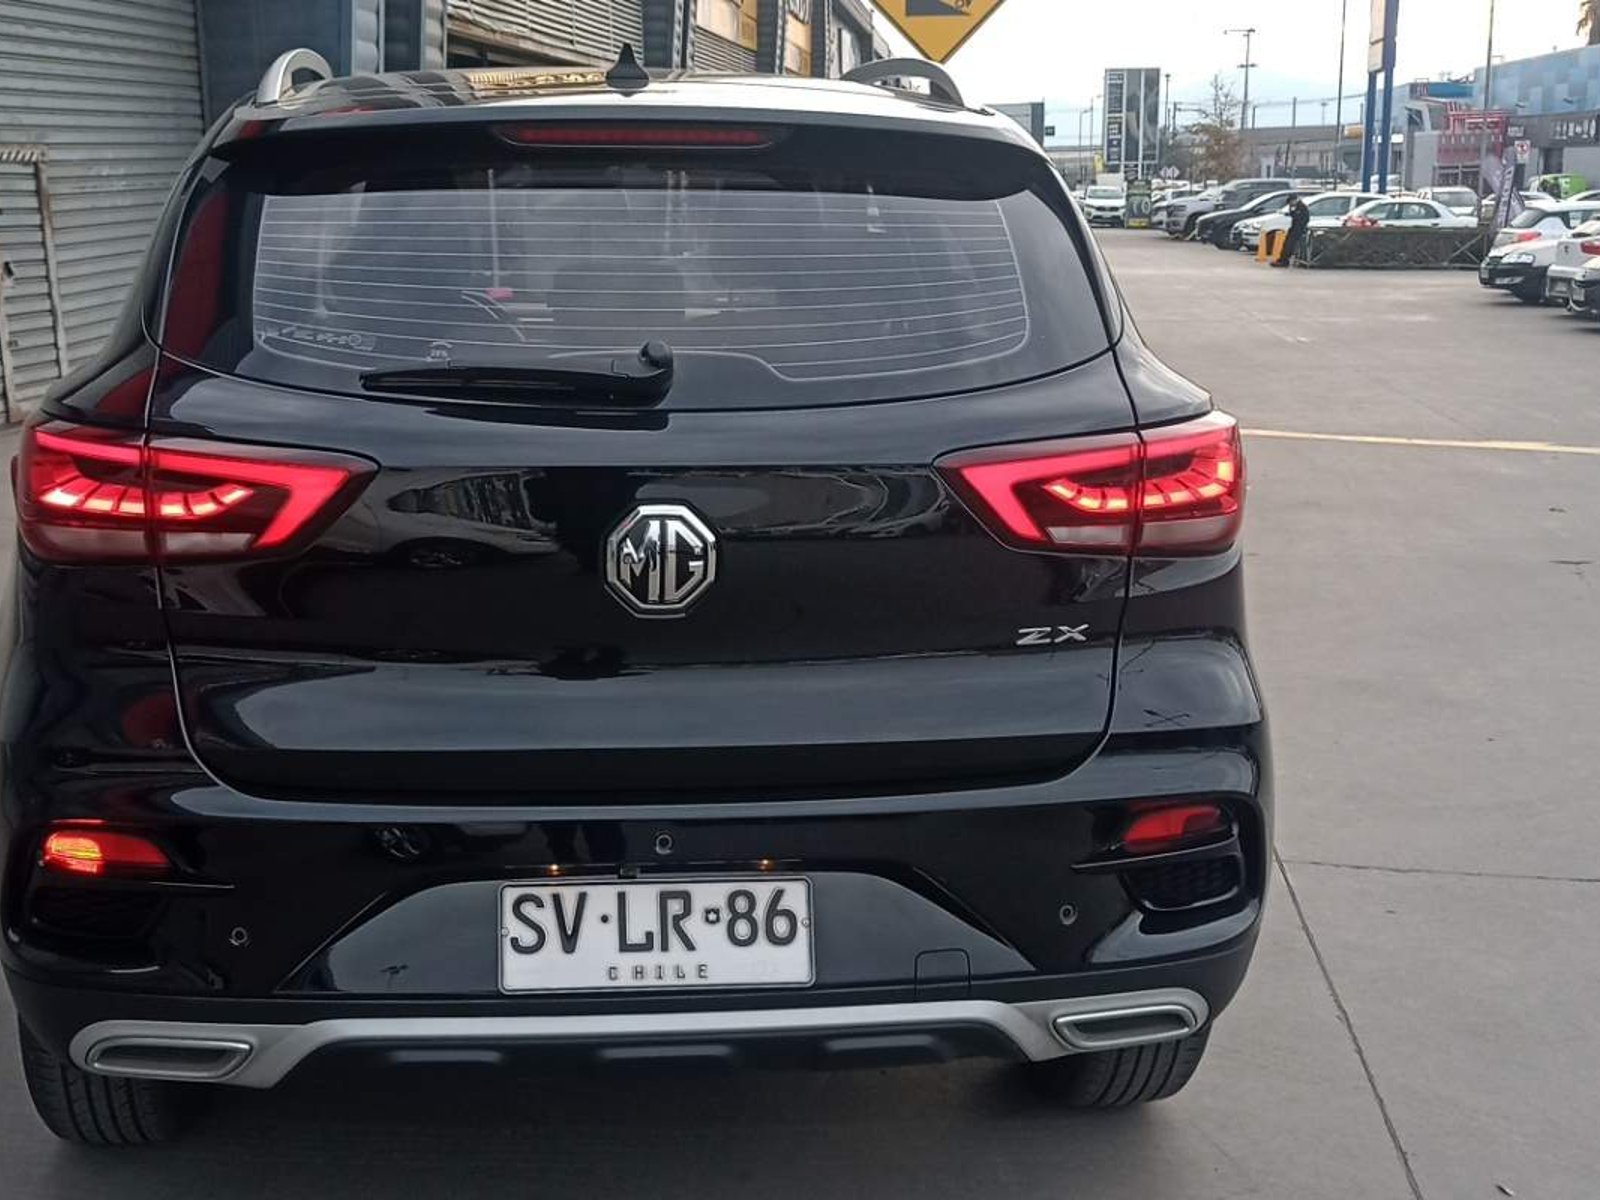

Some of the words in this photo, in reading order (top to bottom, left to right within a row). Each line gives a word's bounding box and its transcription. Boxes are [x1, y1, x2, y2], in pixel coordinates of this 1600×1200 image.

[620, 519, 704, 602] MG
[1016, 624, 1089, 645] ZX
[608, 962, 709, 981] CHILE
